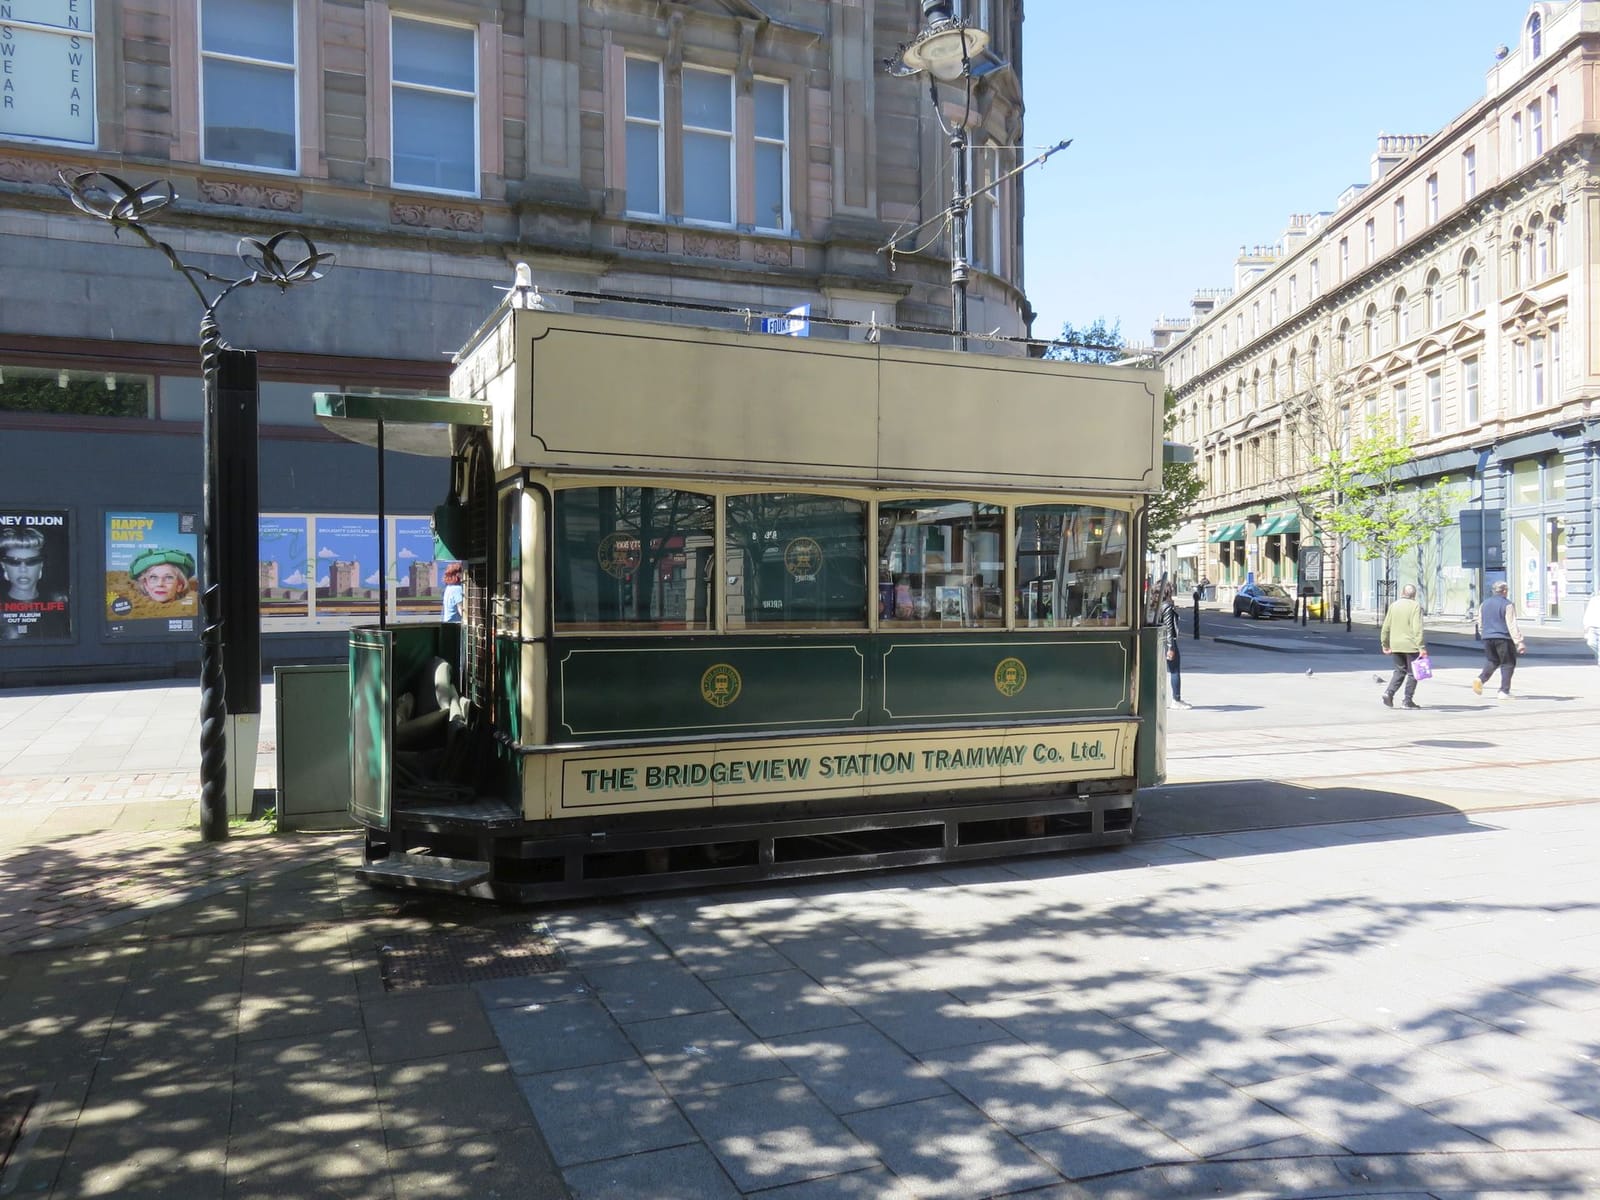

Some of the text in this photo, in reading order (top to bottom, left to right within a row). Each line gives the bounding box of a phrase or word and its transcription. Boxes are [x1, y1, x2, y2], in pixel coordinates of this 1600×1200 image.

[0, 0, 15, 109] NSWEAR
[26, 516, 63, 526] DIJON
[111, 518, 154, 530] HAPPY
[111, 530, 145, 541] DAYS
[5, 601, 65, 611] NIGHTLIFE
[581, 740, 1105, 793] THE BRIDGEVIEW STATION TRAMWAY Co. Ltd.
